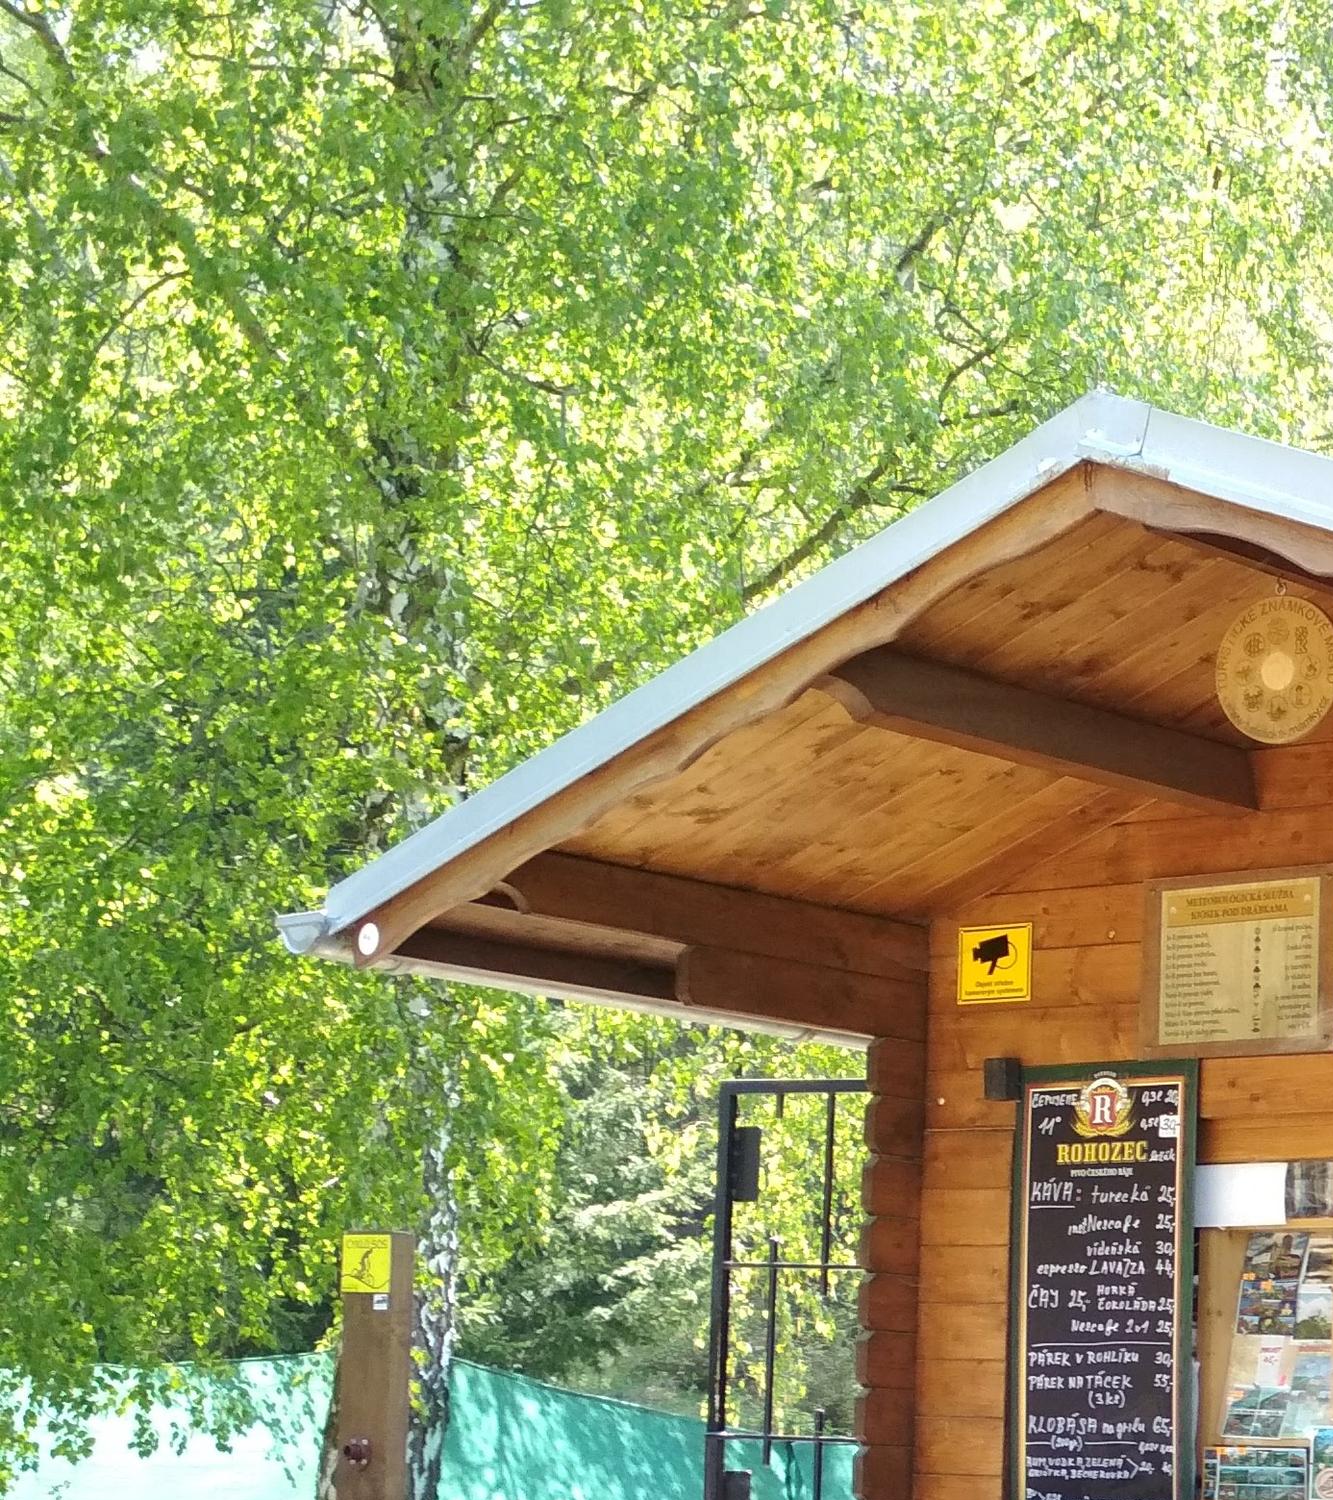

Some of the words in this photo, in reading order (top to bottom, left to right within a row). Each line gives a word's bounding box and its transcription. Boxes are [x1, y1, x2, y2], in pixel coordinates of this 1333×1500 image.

[1092, 1094, 1112, 1124] R
[1056, 1141, 1148, 1165] ROHOZEC
[1028, 1349, 1071, 1367] PÁREK
[1087, 1348, 1139, 1364] ROHLÍKU
[1028, 1374, 1065, 1391] PÁREK
[1028, 1412, 1098, 1435] KLOBÁSA
